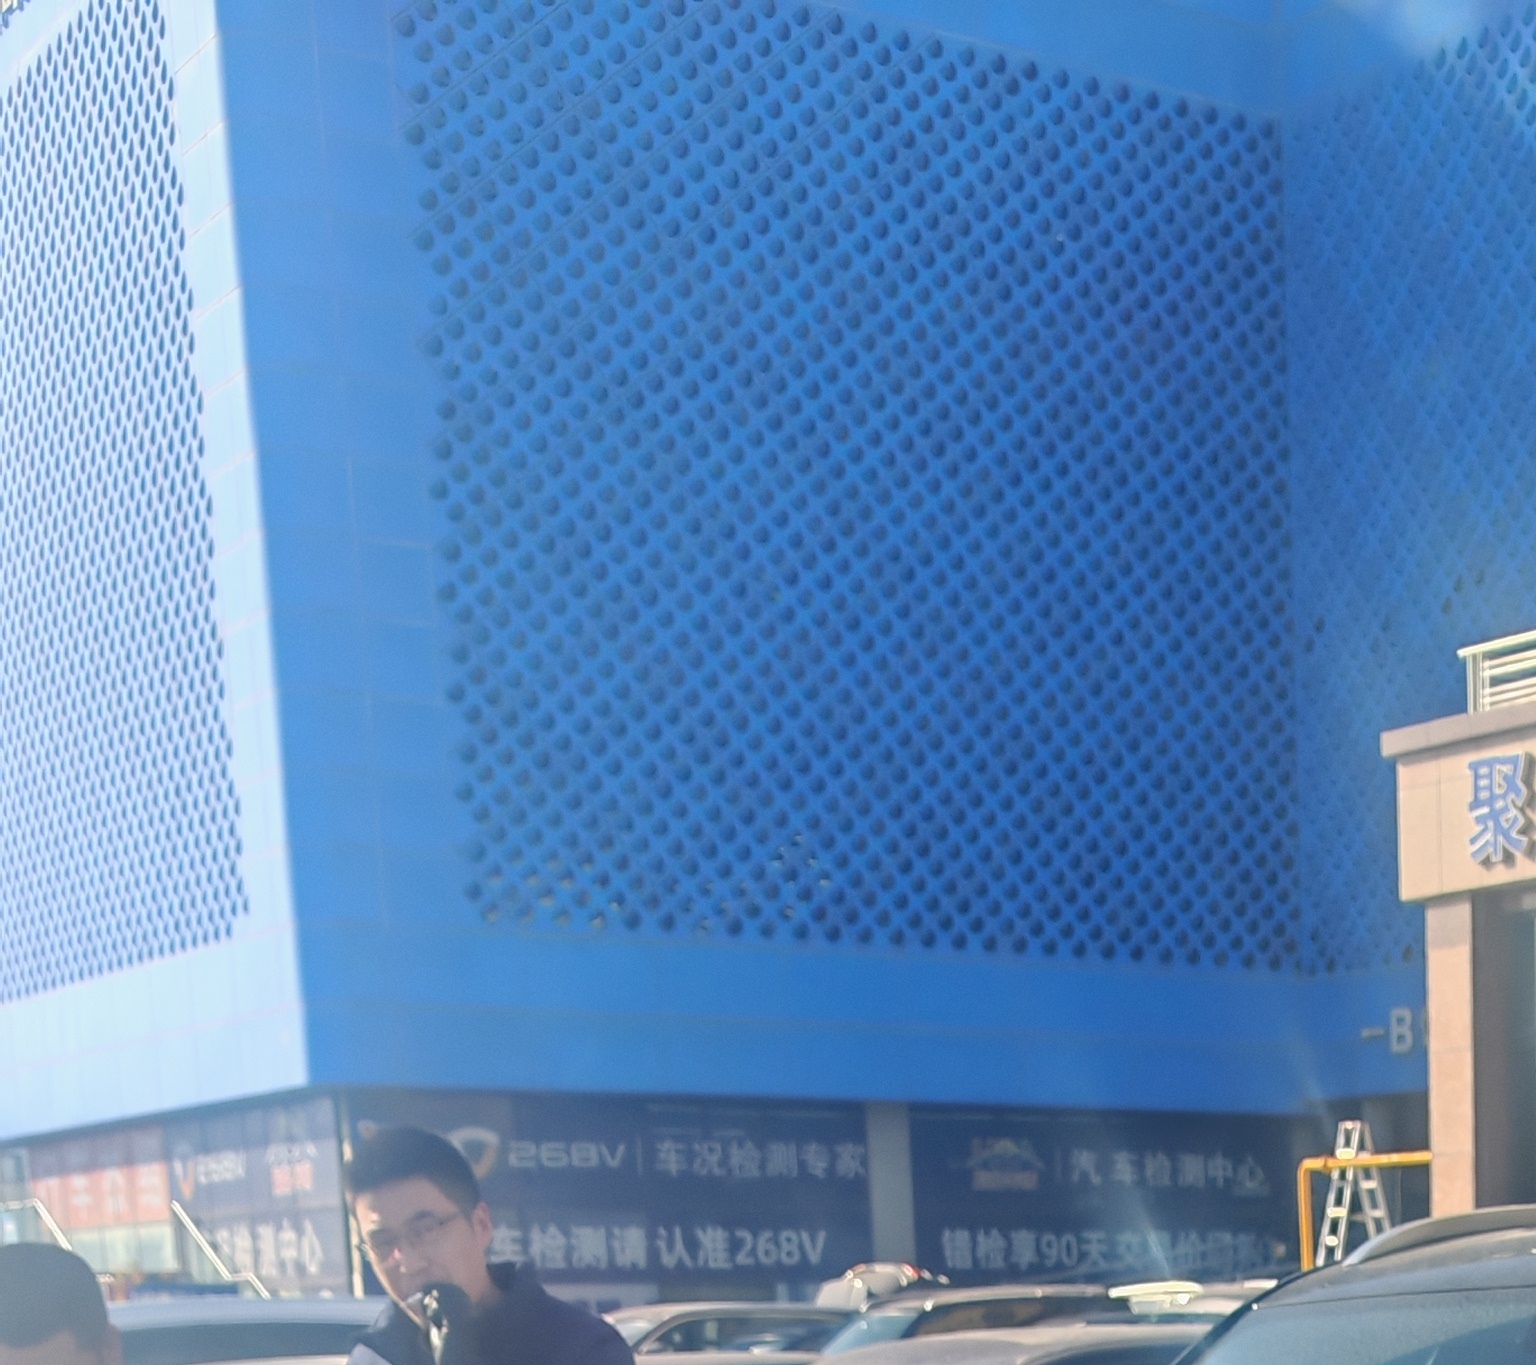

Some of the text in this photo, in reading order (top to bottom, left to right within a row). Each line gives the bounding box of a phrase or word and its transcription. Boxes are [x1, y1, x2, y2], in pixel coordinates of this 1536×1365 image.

[507, 1140, 868, 1179] 268V 车况检测专家
